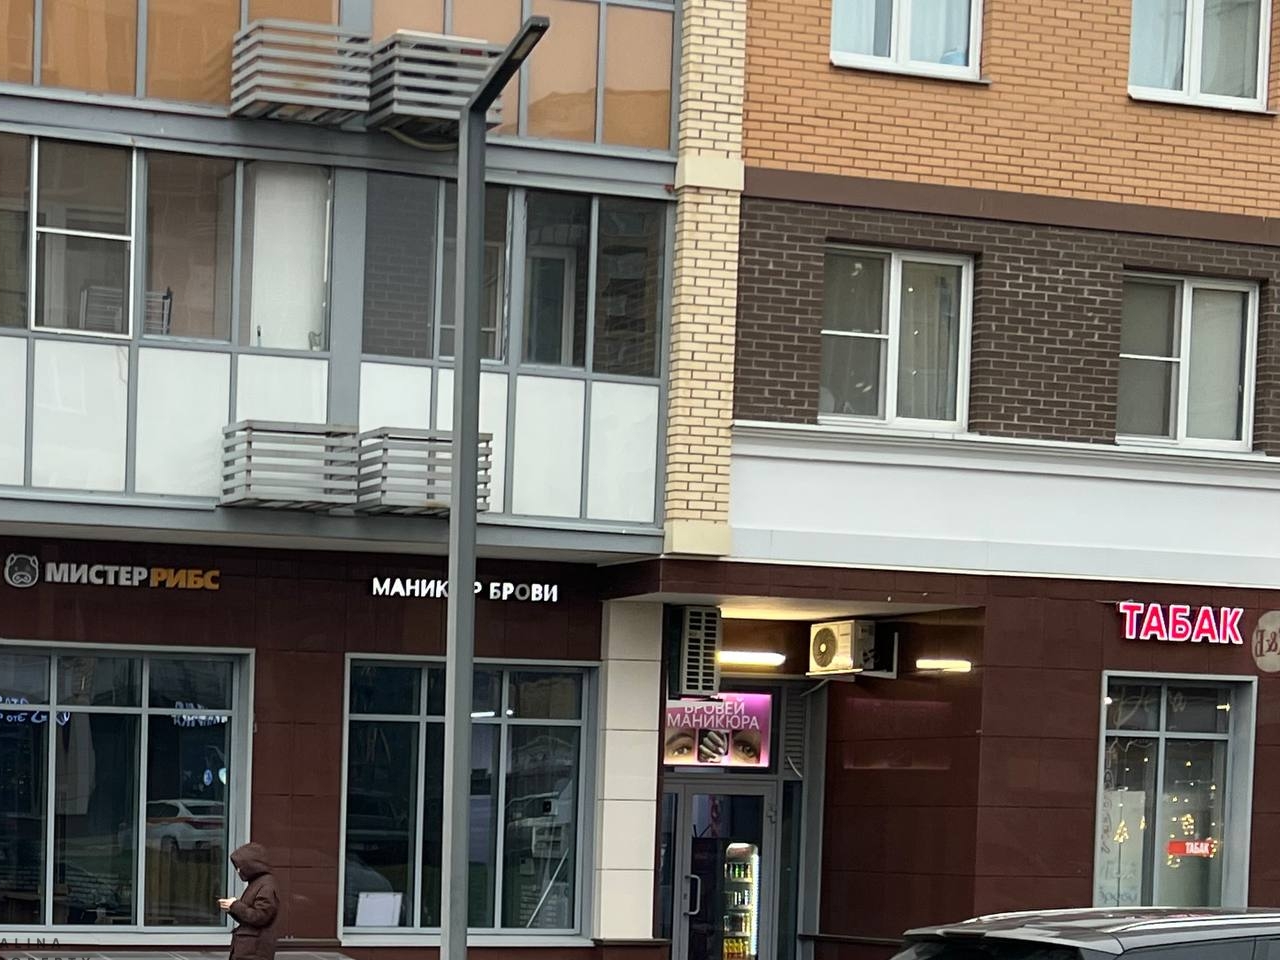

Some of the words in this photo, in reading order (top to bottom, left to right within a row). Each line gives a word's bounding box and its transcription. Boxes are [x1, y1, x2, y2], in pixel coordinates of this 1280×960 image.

[372, 577, 483, 599] МАНИКР
[489, 582, 558, 602] БРОВИ
[1119, 601, 1244, 645] ТАБАК
[667, 713, 760, 730] МАНИКЮРА
[1185, 842, 1210, 854] ТАБАК
